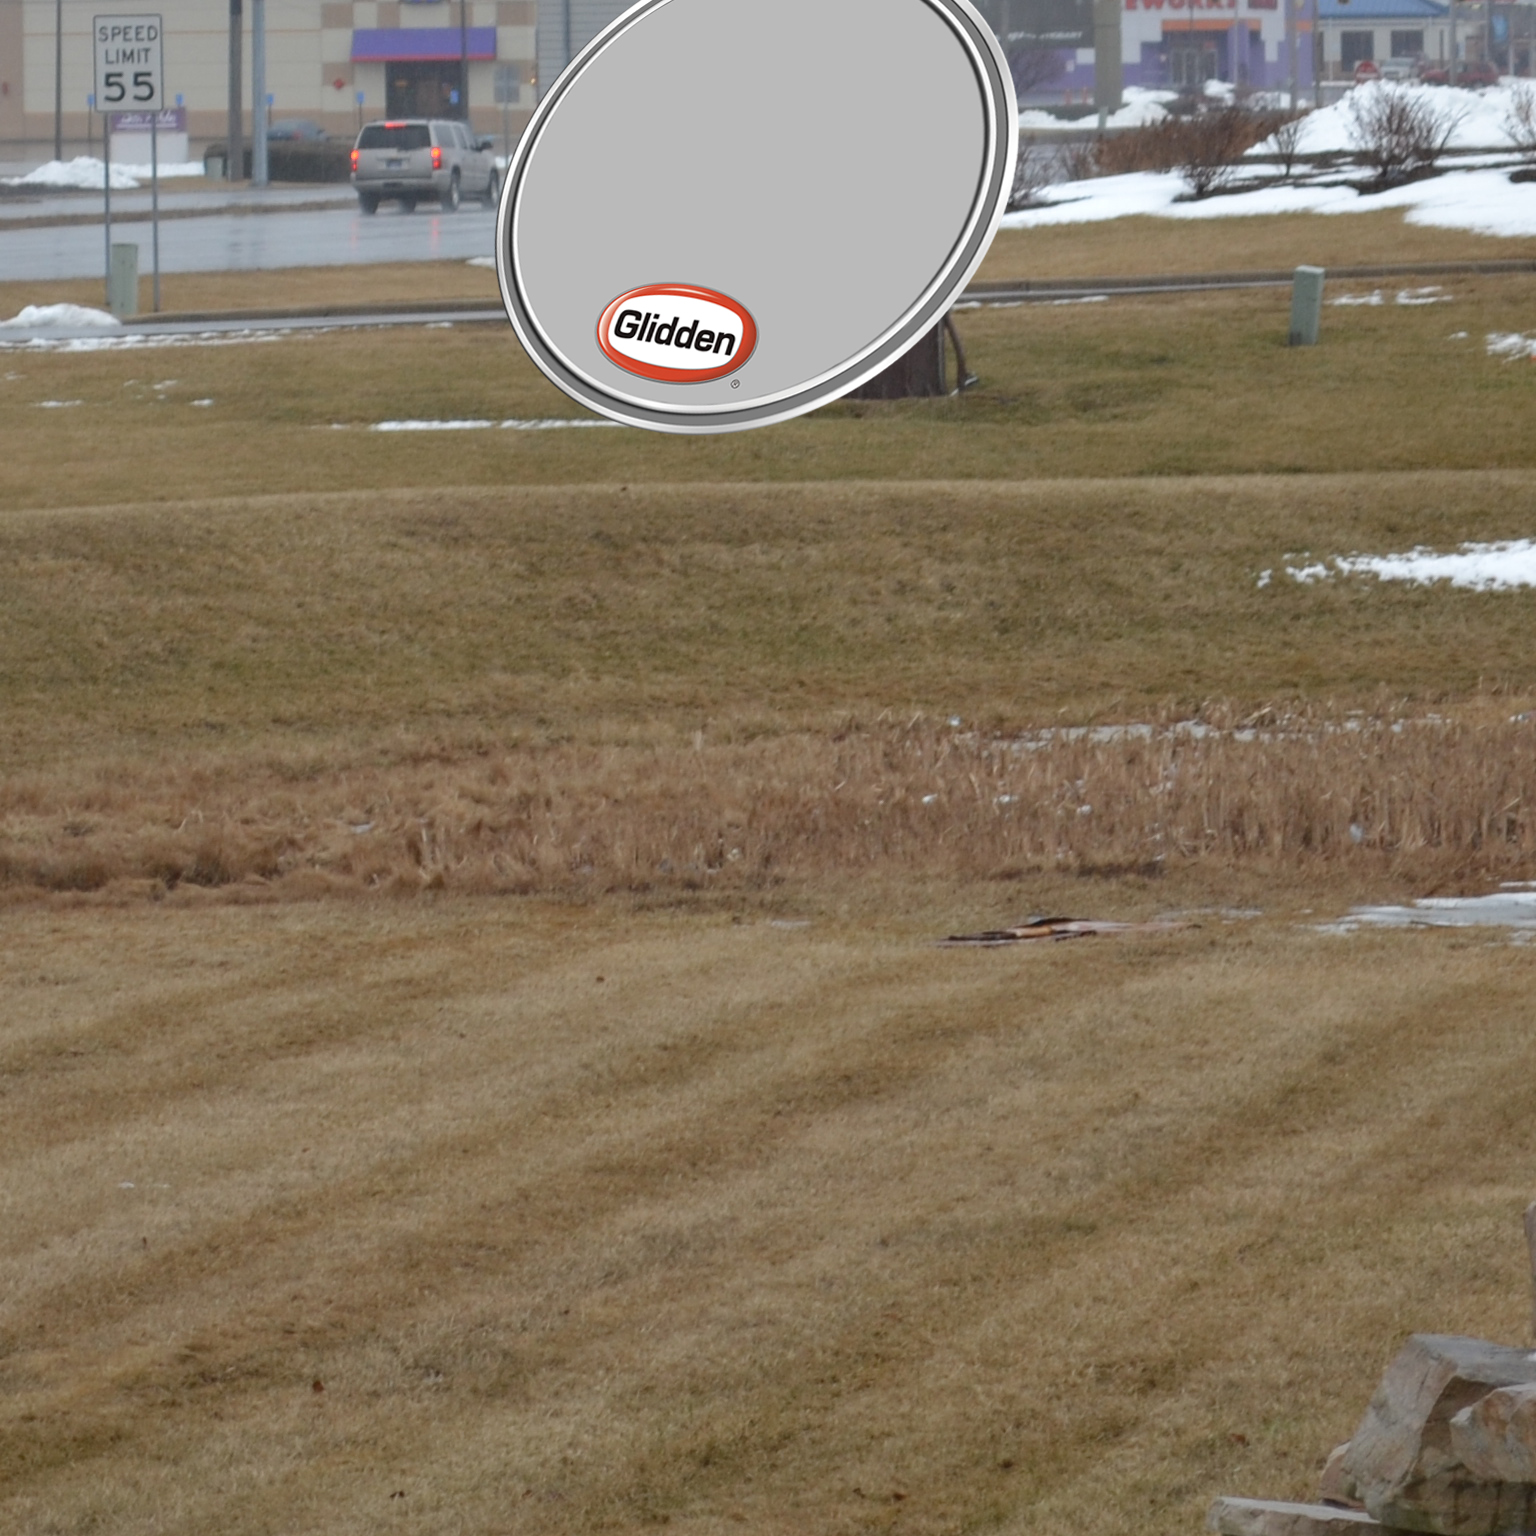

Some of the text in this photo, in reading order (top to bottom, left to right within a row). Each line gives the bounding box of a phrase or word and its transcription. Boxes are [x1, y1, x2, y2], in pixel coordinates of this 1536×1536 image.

[98, 25, 158, 42] SPEED
[105, 48, 151, 64] LIMIT
[104, 72, 155, 102] 55
